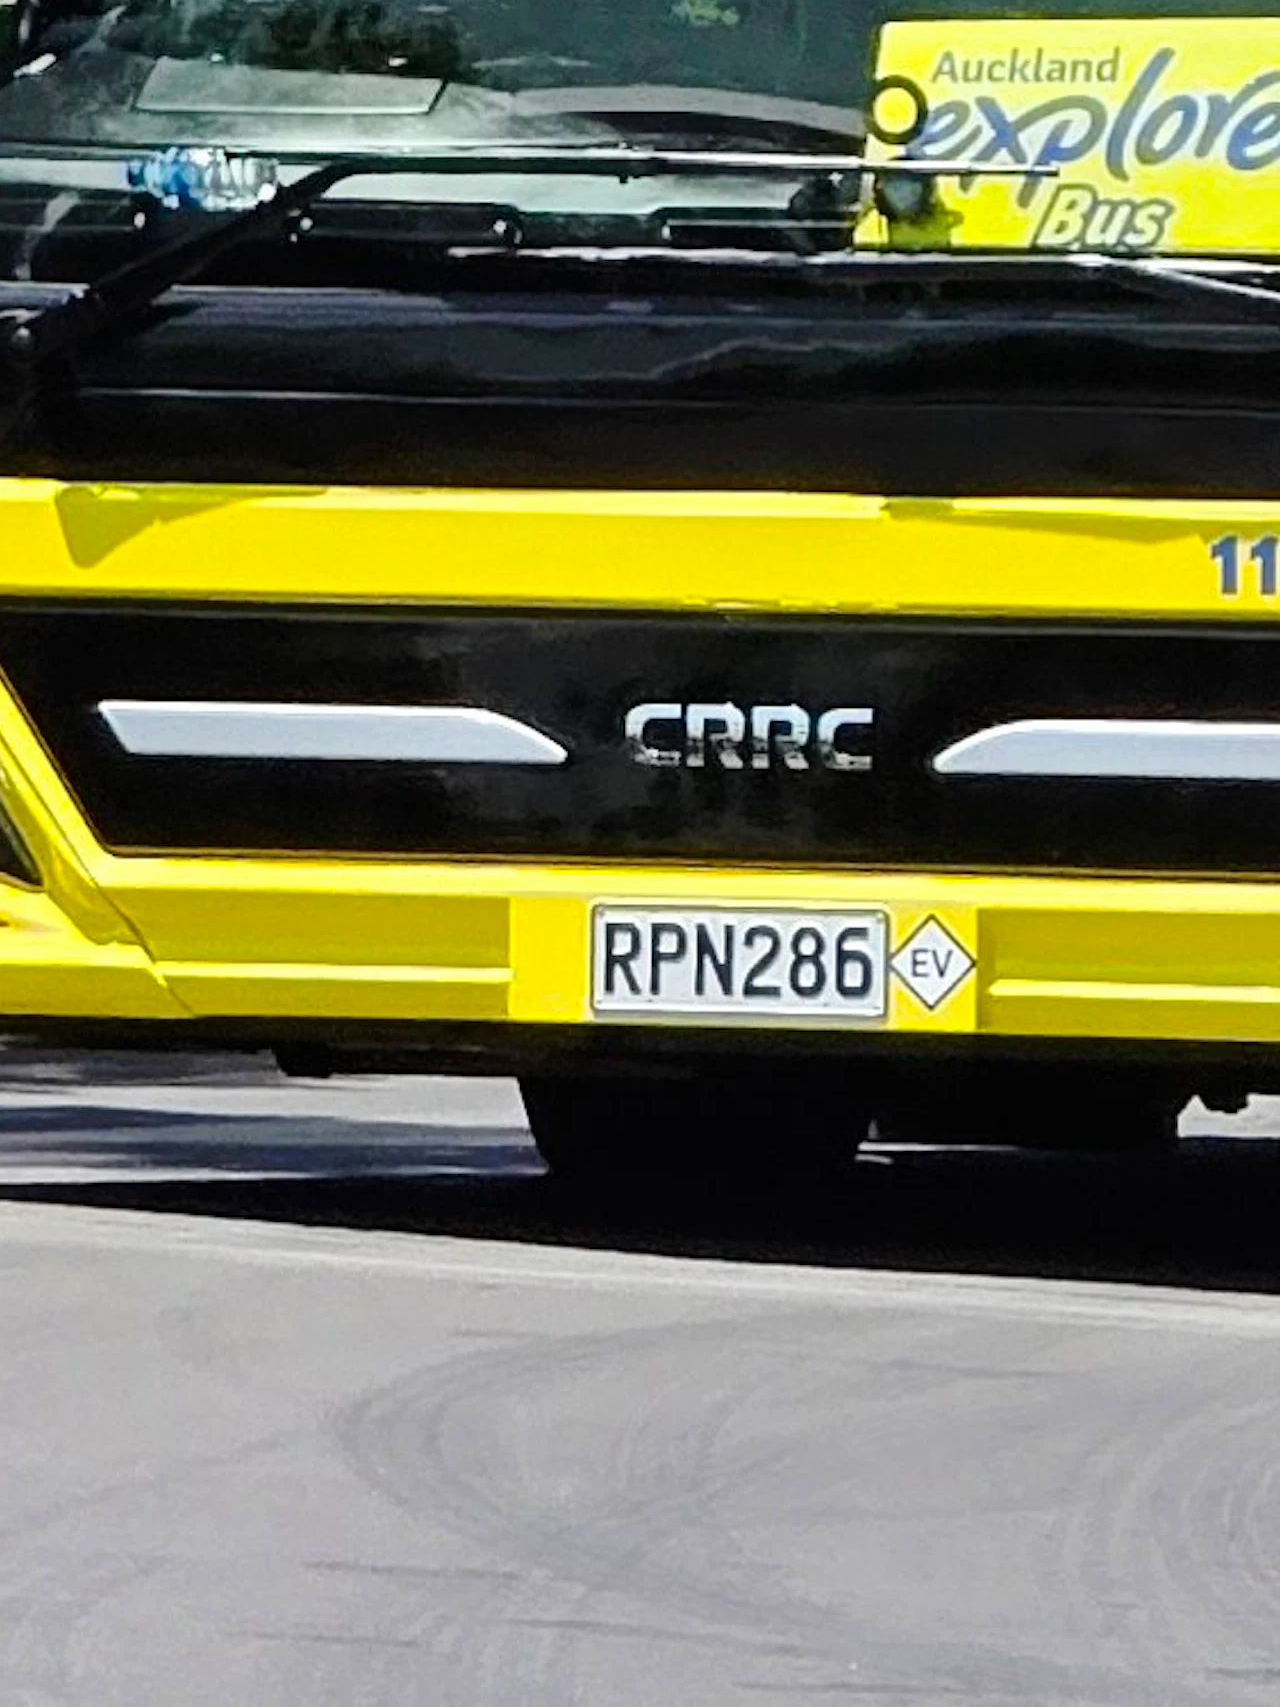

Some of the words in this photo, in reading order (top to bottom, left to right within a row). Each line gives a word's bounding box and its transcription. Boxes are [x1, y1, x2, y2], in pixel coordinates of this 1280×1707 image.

[931, 46, 1121, 84] Auckland
[1034, 184, 1172, 249] Bus
[623, 702, 874, 771] CRRC
[603, 923, 876, 1001] RPN286
[909, 946, 953, 980] EV
